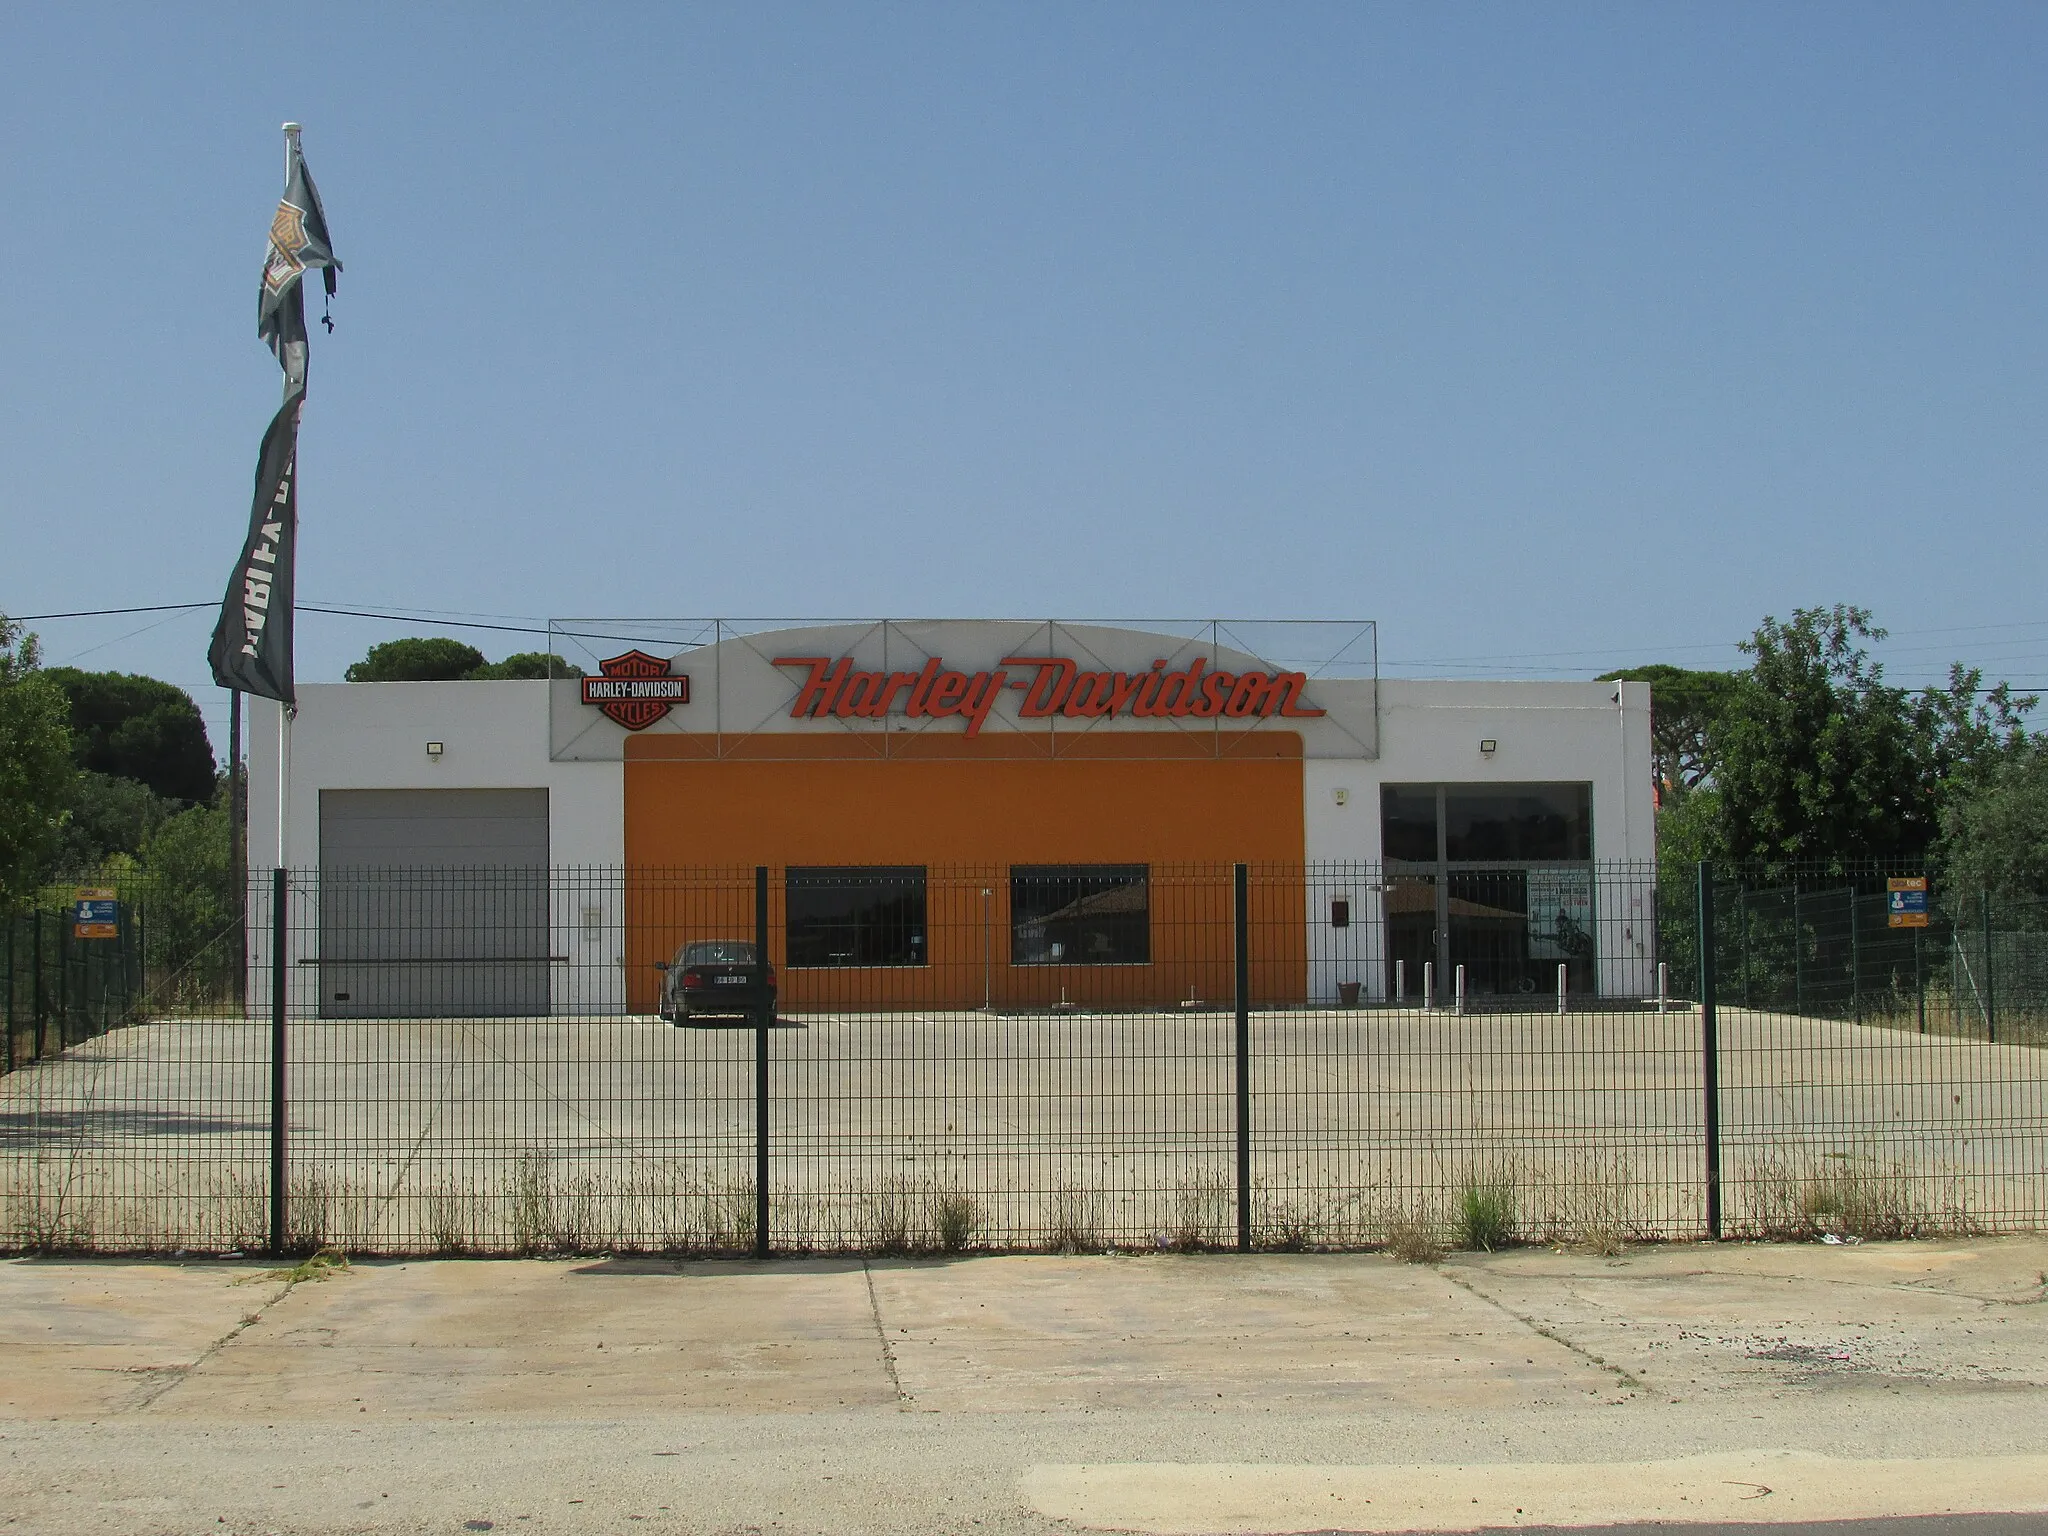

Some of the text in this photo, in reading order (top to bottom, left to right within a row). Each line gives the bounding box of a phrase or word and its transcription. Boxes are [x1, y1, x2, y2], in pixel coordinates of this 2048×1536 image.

[611, 660, 660, 676] MOTOR
[589, 681, 682, 698] HARLEY-DAVIDSON
[771, 657, 1327, 739] Harley-Davidson
[611, 702, 661, 723] CYCLES
